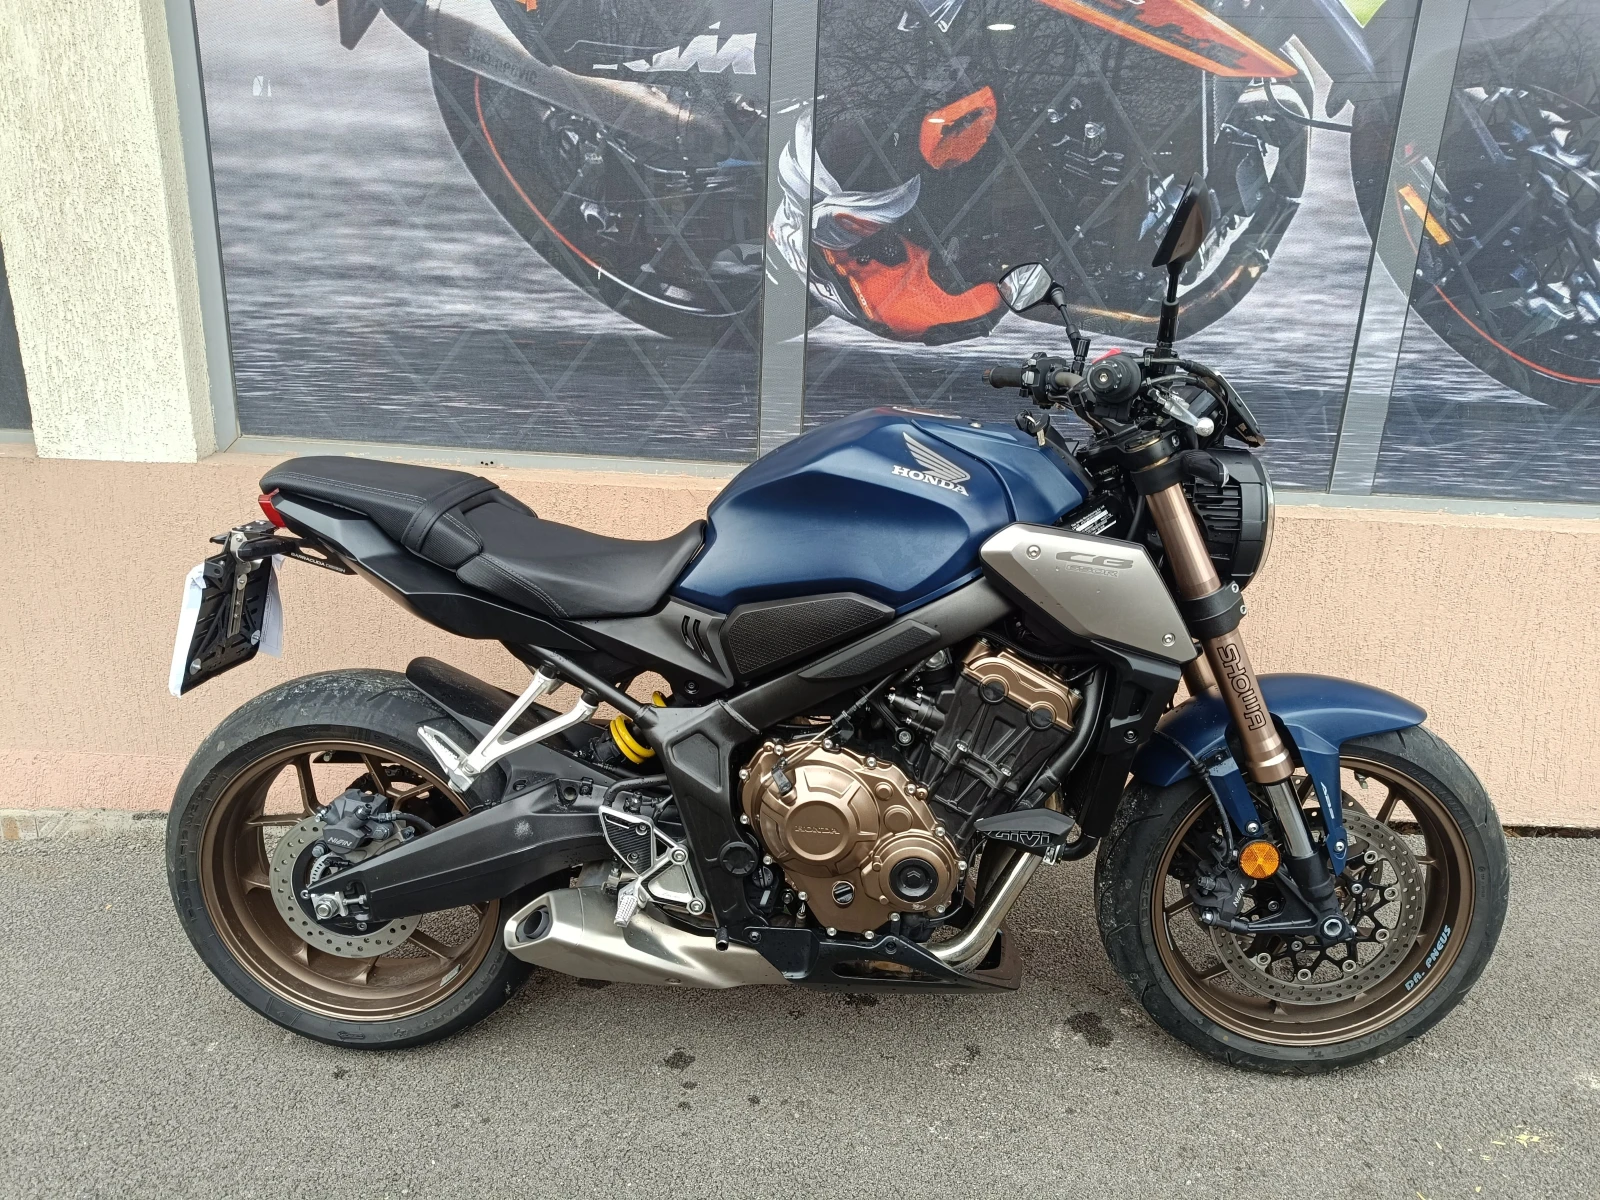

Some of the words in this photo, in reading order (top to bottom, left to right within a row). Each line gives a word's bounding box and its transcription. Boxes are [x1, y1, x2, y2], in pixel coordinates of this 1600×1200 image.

[891, 464, 970, 497] HONDA
[290, 552, 326, 568] BARRACUDA
[1055, 550, 1134, 570] CB
[1216, 643, 1267, 732] SHOWA
[795, 824, 841, 836] HONDA
[1404, 971, 1426, 992] DR.
[1425, 924, 1452, 970] PNEUS
